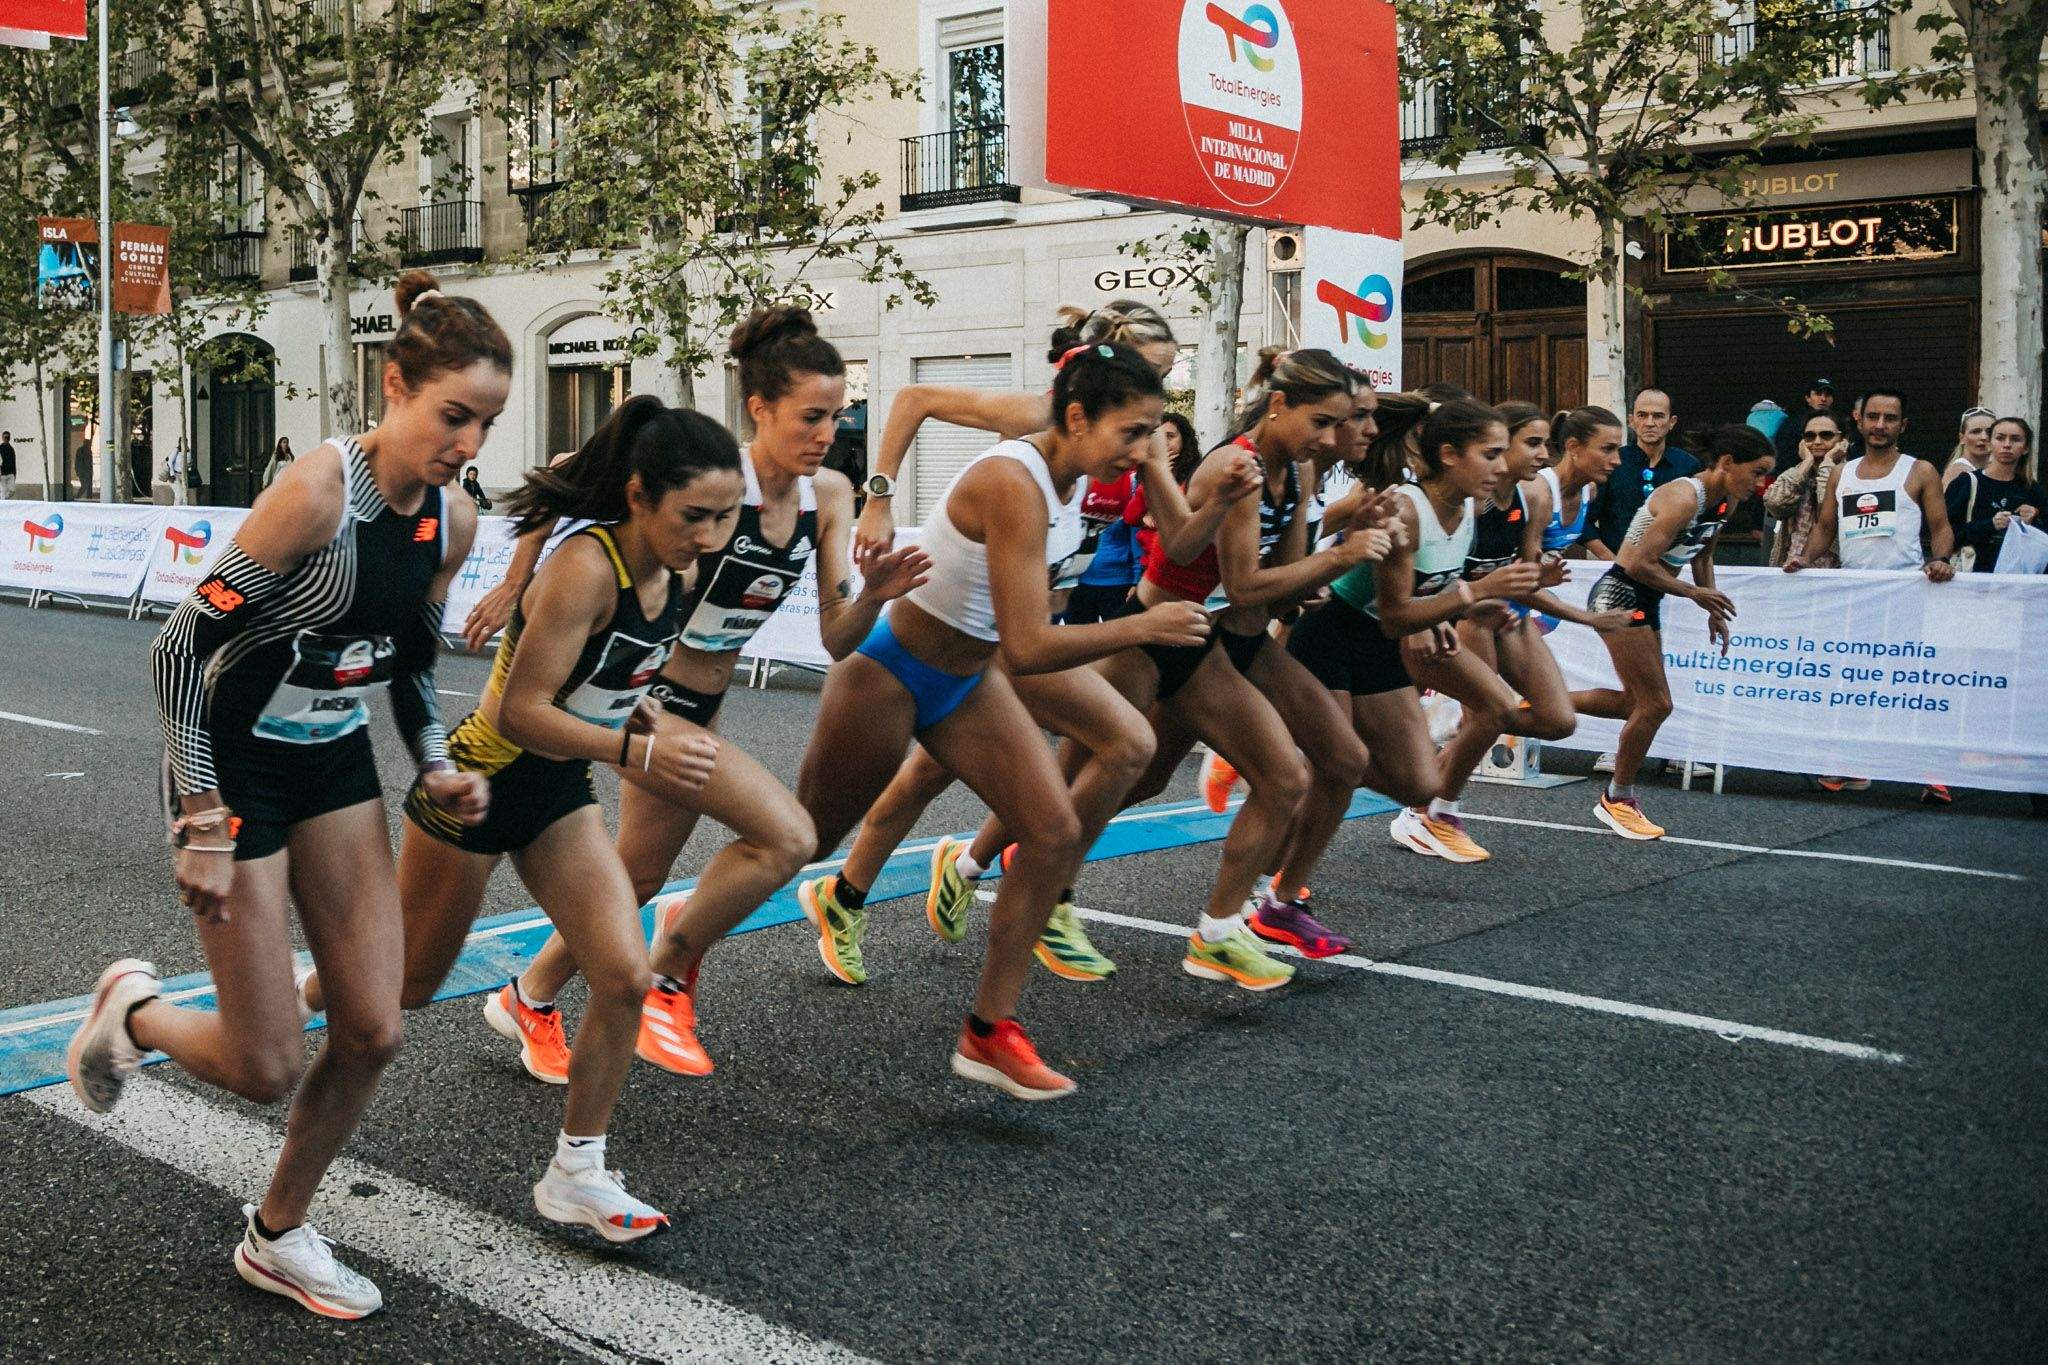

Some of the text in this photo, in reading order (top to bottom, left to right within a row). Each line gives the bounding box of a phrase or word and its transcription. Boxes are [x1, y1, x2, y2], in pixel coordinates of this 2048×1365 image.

[1209, 73, 1281, 107] TotalEnergies
[1229, 121, 1263, 144] MILLA
[1215, 161, 1275, 188] DE MADRID
[1743, 172, 1839, 197] UBLOT
[43, 227, 68, 240] ISLA
[120, 240, 164, 254] FERNÁN
[120, 251, 164, 265] GÓMEZ
[124, 270, 159, 279] CULTURAL
[128, 264, 156, 272] CENTRO
[131, 277, 141, 285] LA
[1094, 264, 1204, 291] GEOX
[549, 340, 600, 355] MICHAEL
[1857, 513, 1879, 529] 775
[13, 560, 55, 576] TotalEnergies
[1797, 635, 1815, 652] la
[1823, 640, 1937, 658] compañía
[1841, 666, 1884, 682] que
[1892, 669, 2008, 689] patrocina
[1695, 679, 1950, 712] tus carreras preferidas
